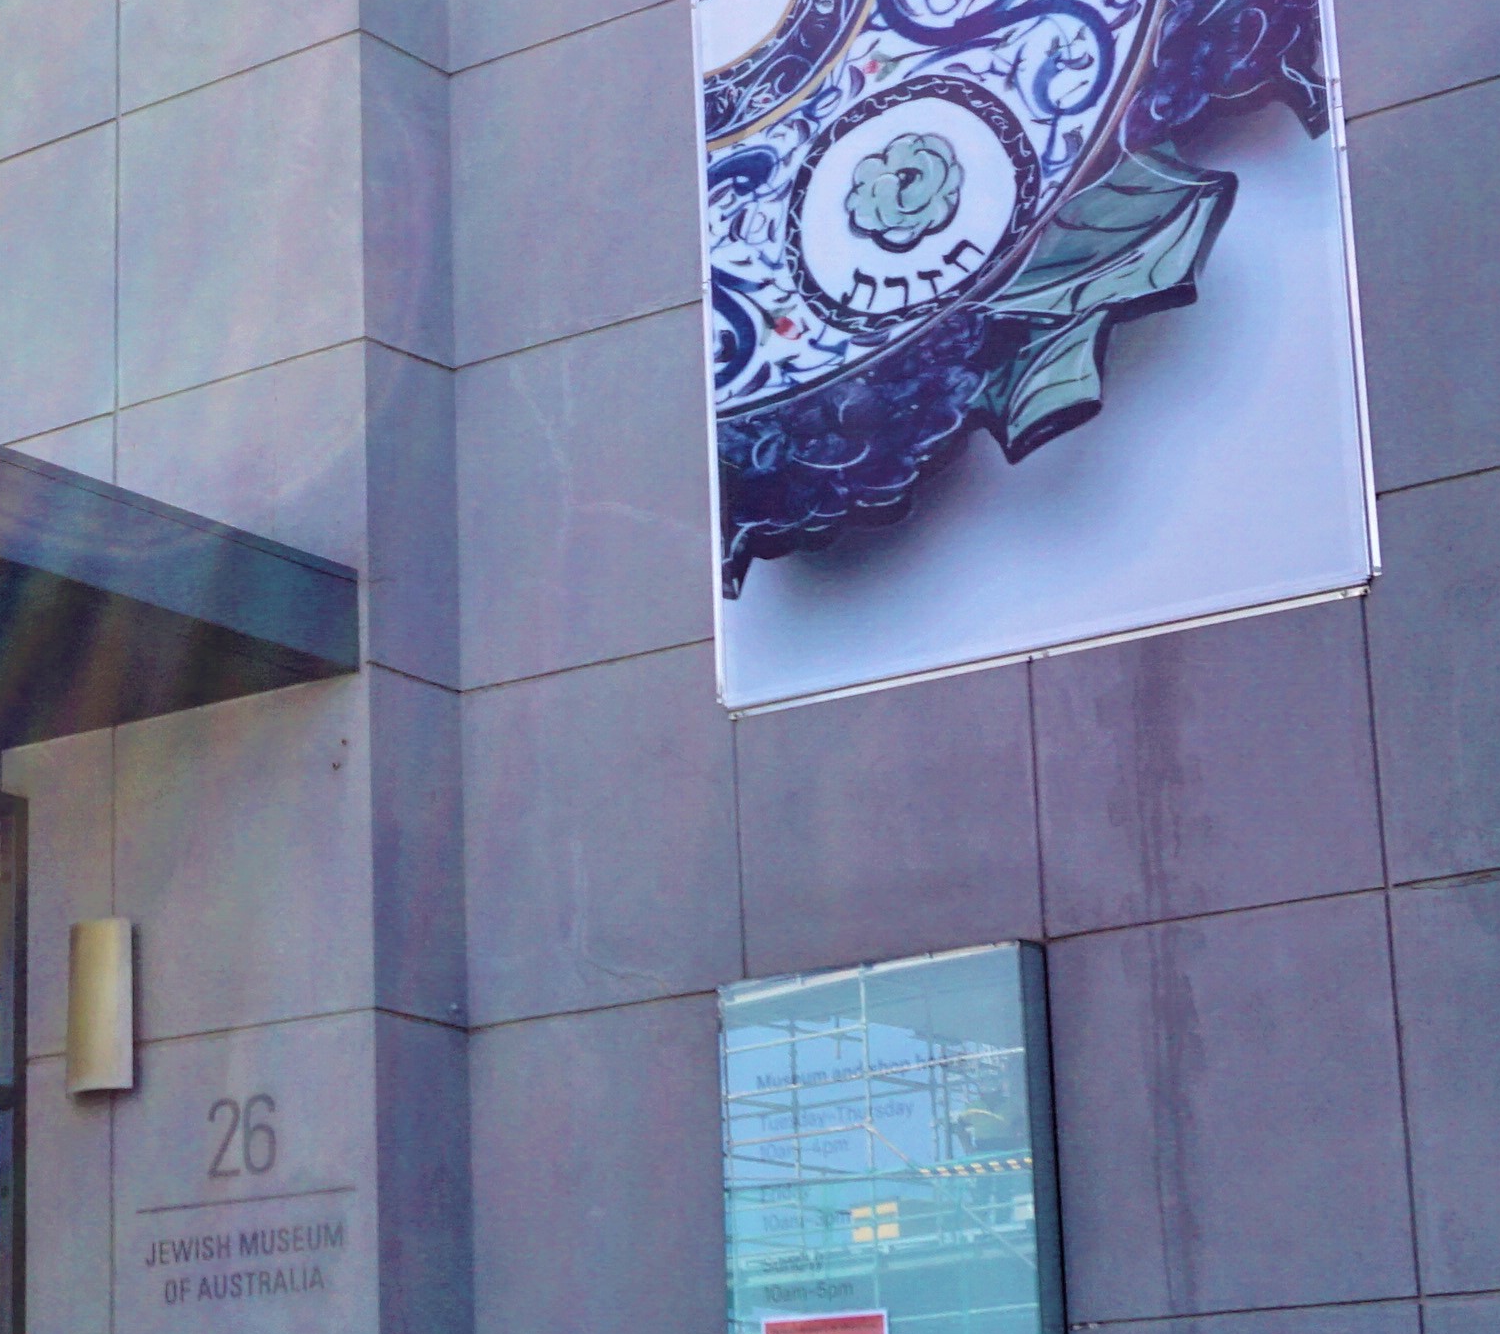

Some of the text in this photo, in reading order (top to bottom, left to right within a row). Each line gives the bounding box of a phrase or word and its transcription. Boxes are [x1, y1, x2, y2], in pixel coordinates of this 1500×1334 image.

[206, 1092, 277, 1180] 26
[144, 1221, 345, 1268] JEWISH MUSEUM
[164, 1266, 325, 1306] OF AUSTRALIA
